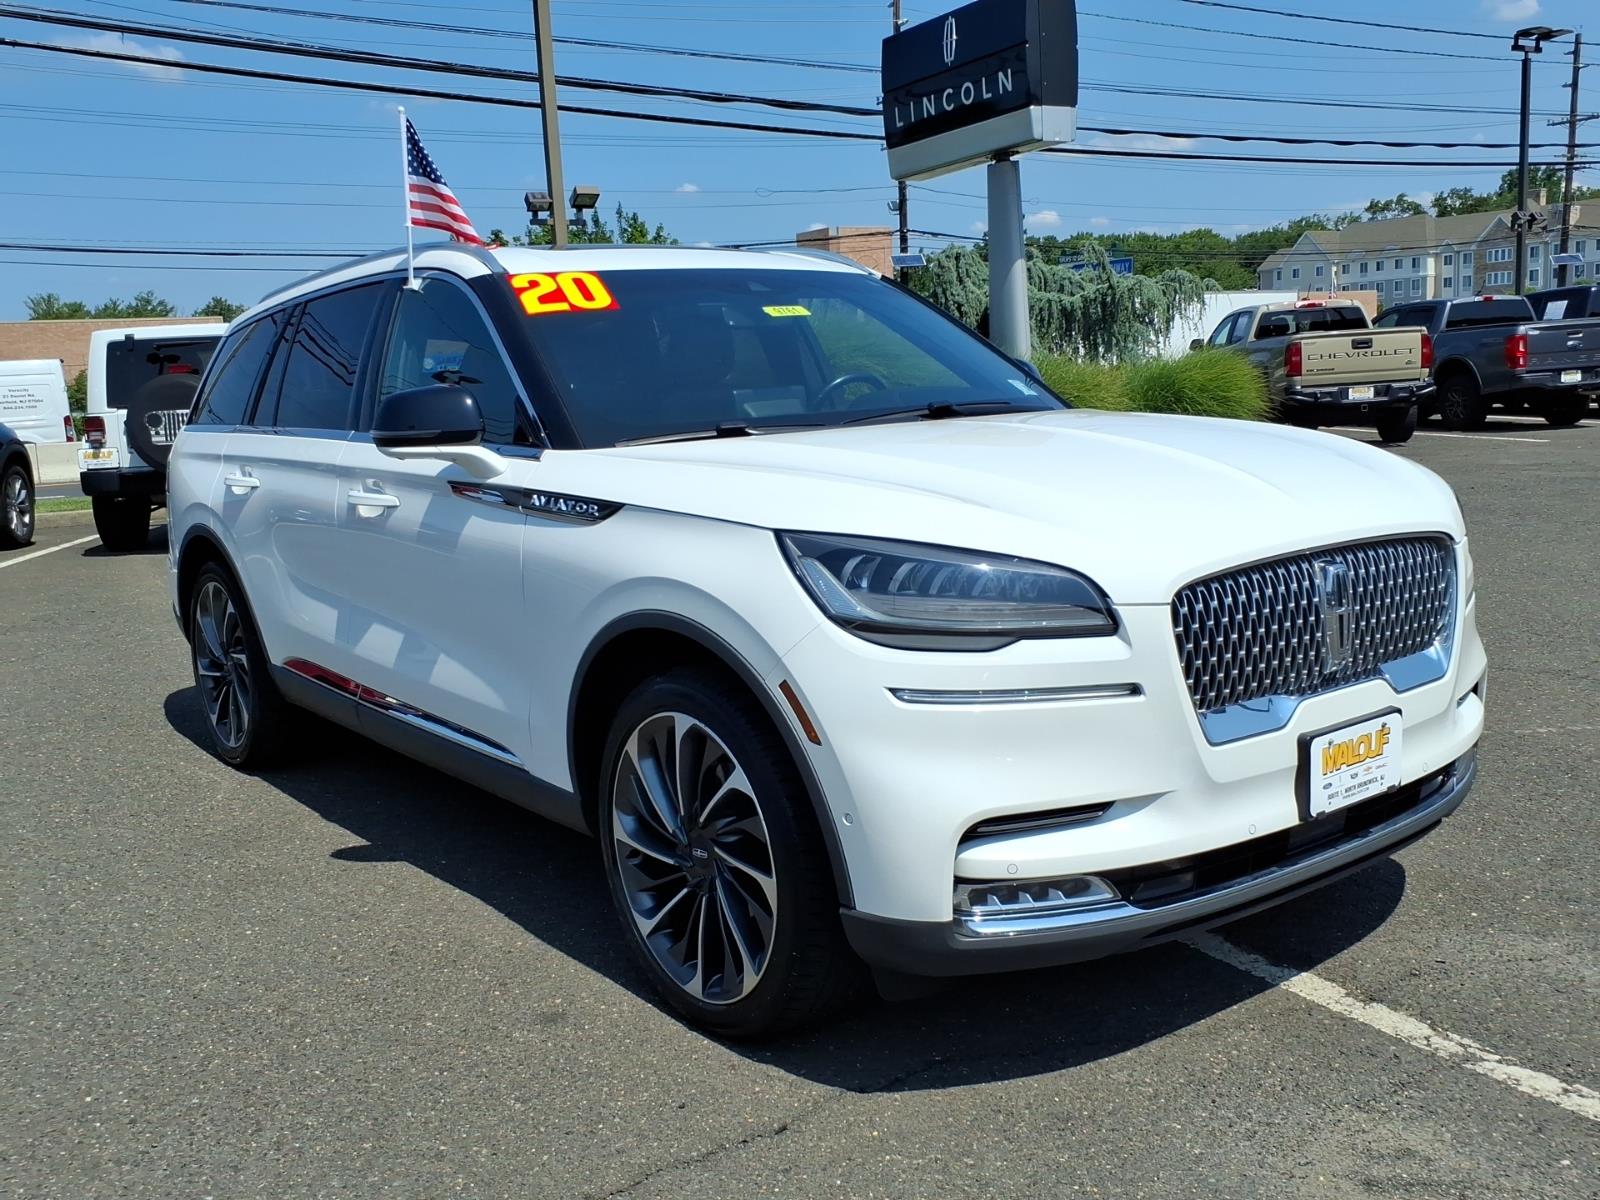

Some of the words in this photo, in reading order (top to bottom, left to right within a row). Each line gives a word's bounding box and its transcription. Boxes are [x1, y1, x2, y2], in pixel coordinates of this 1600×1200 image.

[894, 67, 1013, 128] LINCOLN
[511, 271, 613, 315] 20
[1307, 347, 1417, 361] CHEVROLET
[529, 494, 600, 517] AVIATOR
[1321, 726, 1391, 777] MALOUF
